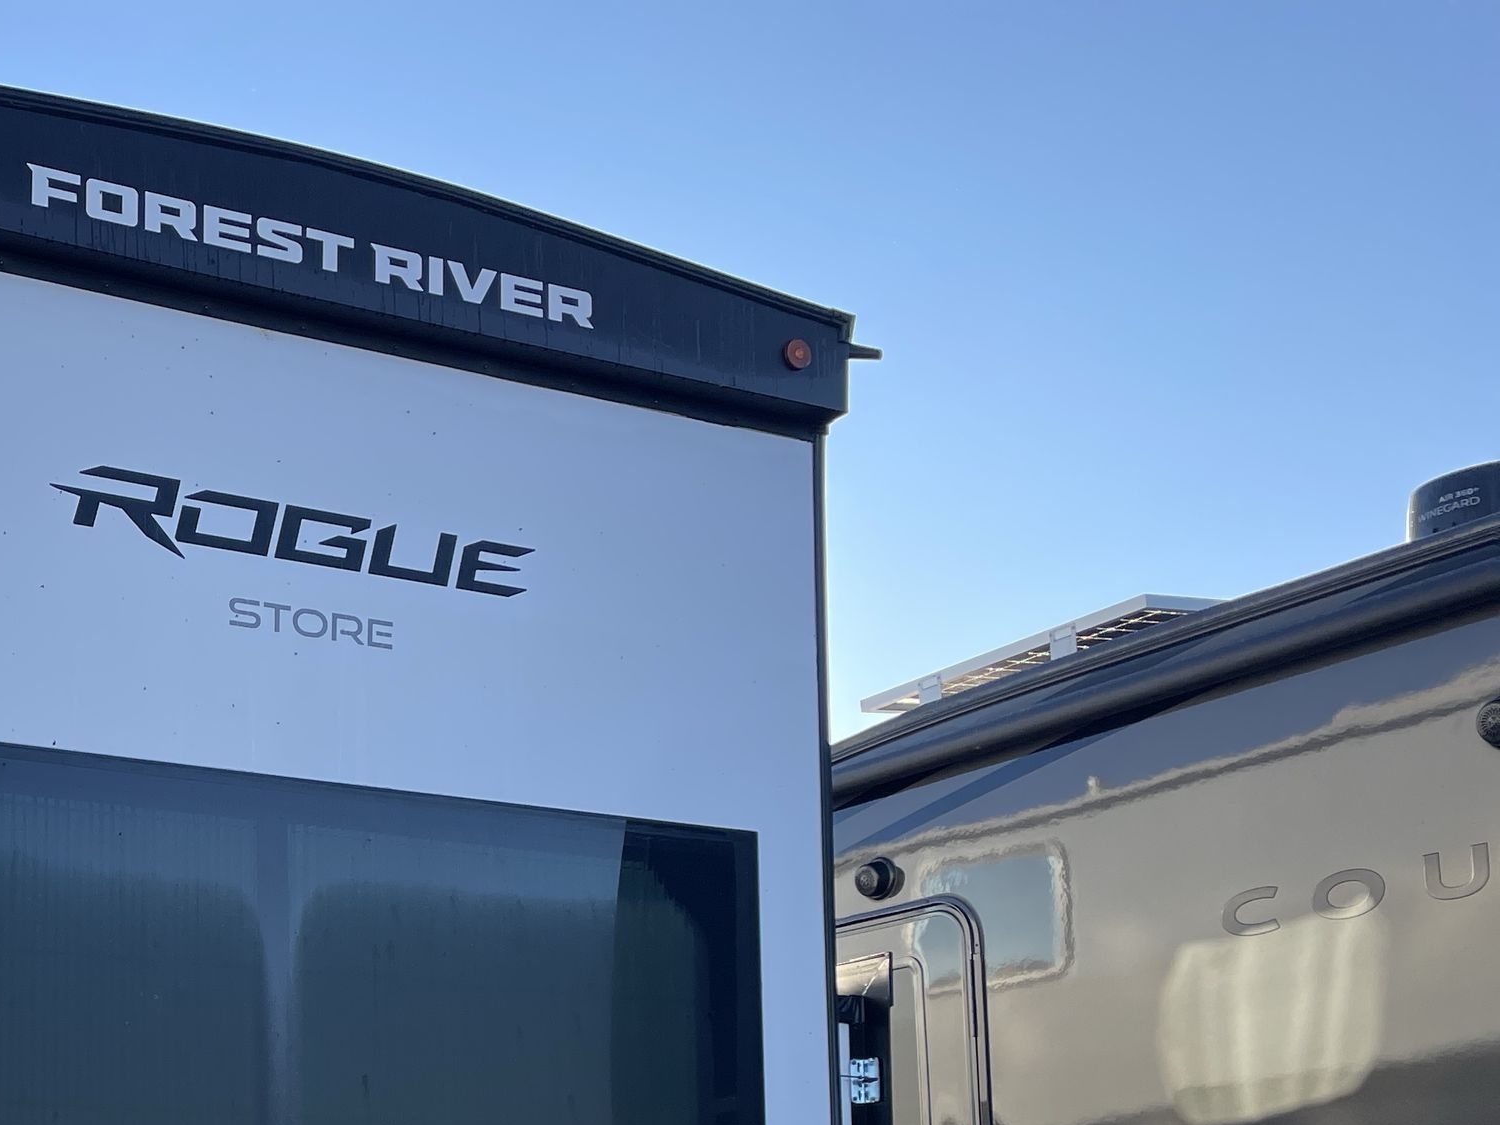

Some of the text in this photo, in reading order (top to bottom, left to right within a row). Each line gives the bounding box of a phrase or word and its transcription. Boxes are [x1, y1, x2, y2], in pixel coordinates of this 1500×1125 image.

[26, 161, 594, 329] FOREST RIVER
[49, 465, 536, 598] ROGUE
[1418, 496, 1481, 522] WINEGARD
[228, 597, 394, 650] STORE
[1221, 841, 1491, 937] COU
